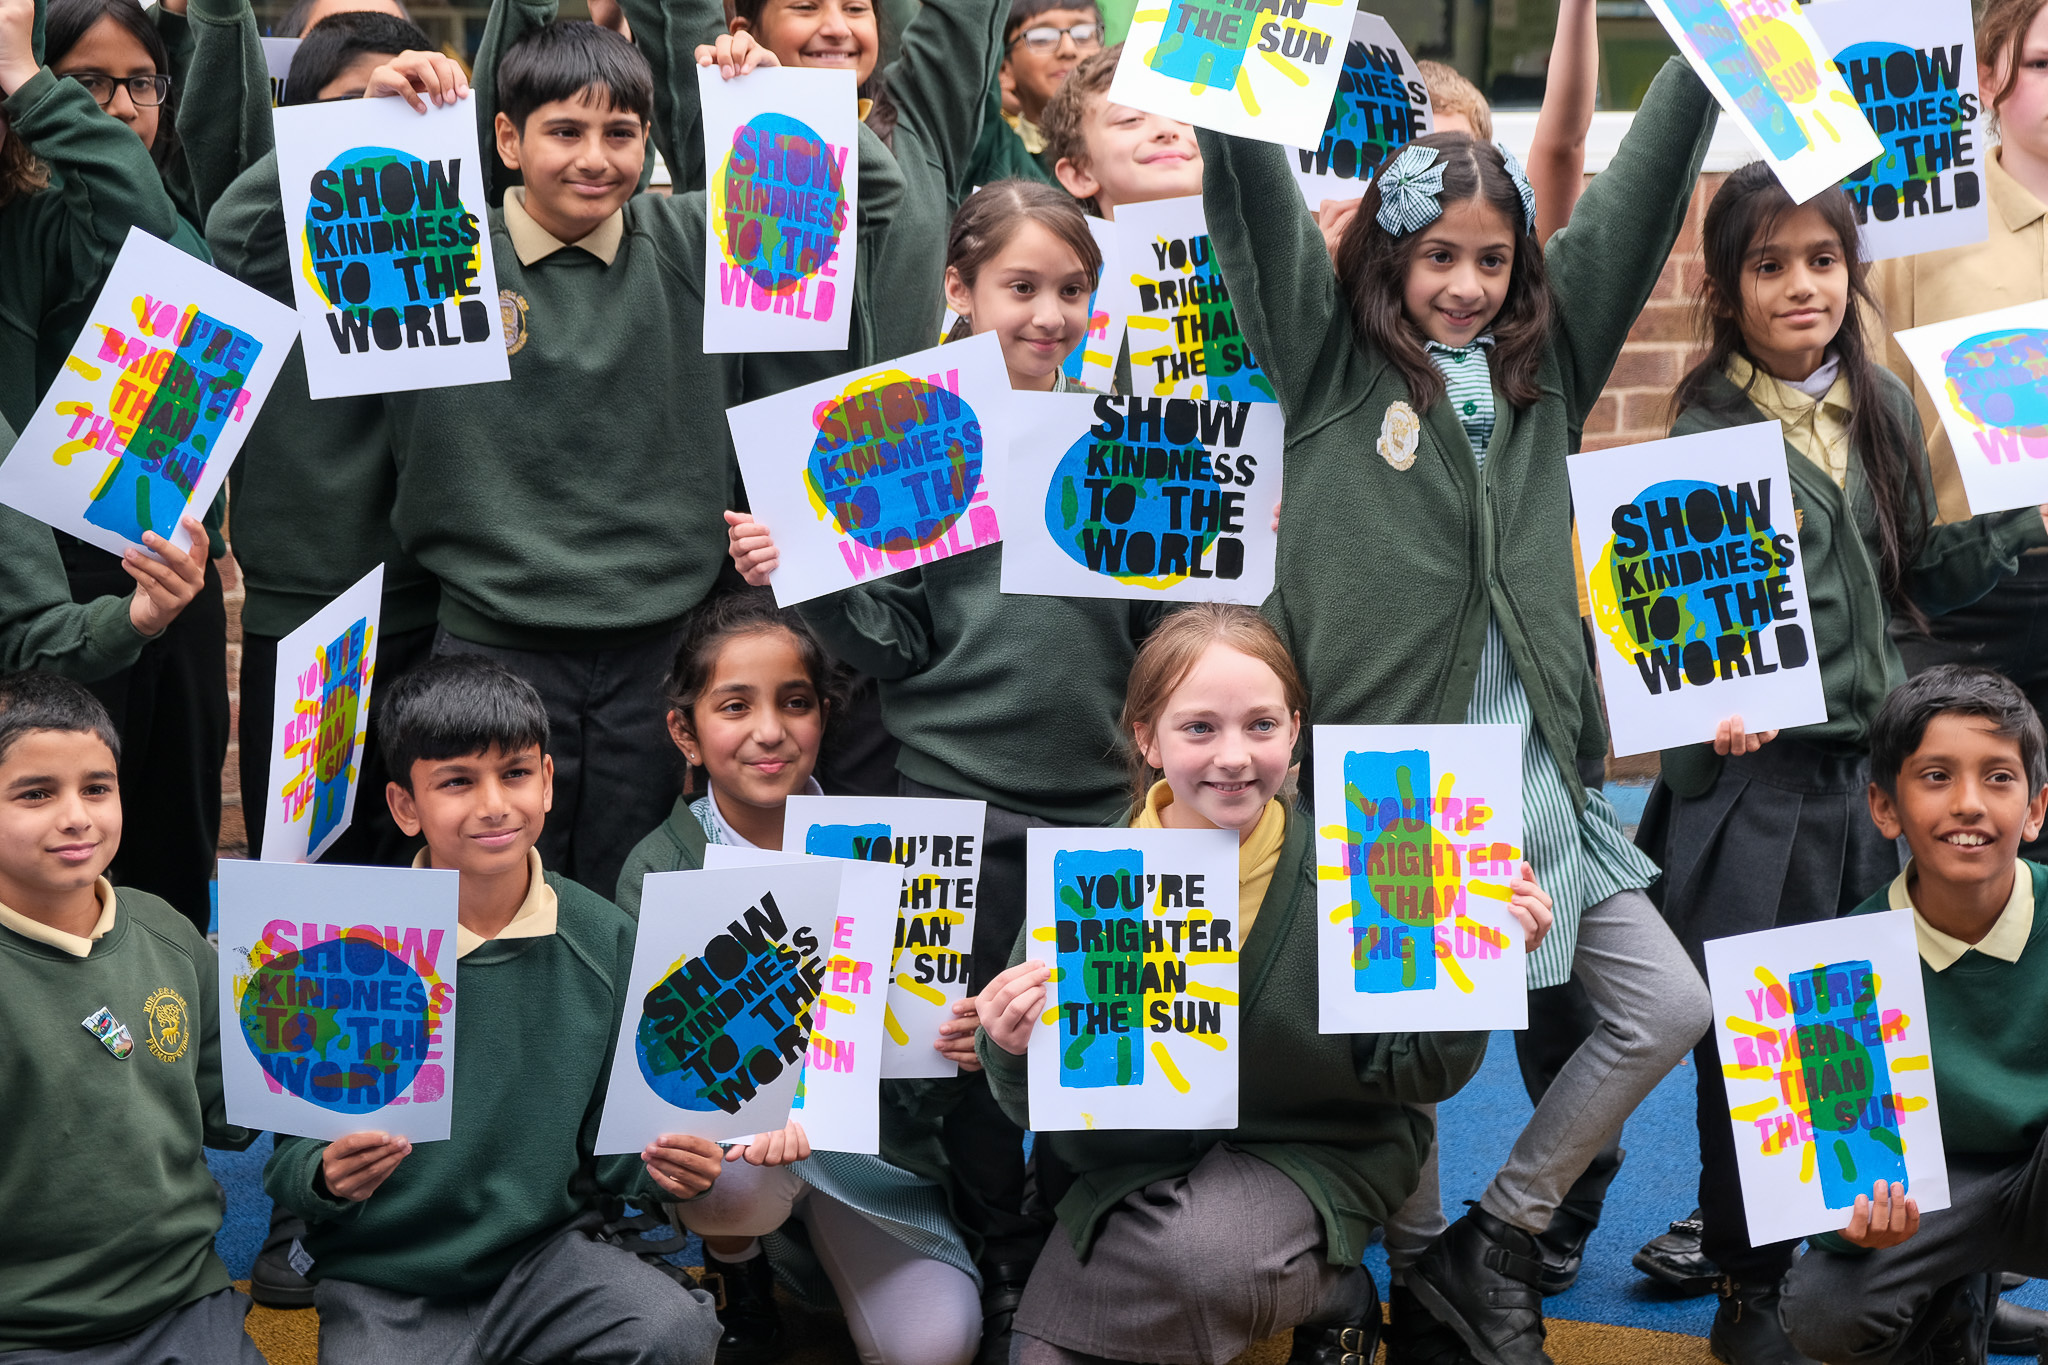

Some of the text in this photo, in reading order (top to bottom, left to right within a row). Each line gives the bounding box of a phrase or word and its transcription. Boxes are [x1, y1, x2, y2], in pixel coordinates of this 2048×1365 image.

[1177, 4, 1332, 64] THE SUN
[1344, 40, 1404, 75] OW
[1338, 71, 1427, 105] DNESS
[1771, 58, 1822, 103] SUN
[1835, 44, 1963, 103] HOW
[1356, 101, 1426, 144] THE
[1866, 93, 1978, 134] DNESS
[730, 125, 848, 192] SHOW
[1299, 136, 1394, 181] WOR
[1895, 129, 1975, 176] THE
[310, 158, 462, 222] SHOW
[726, 177, 849, 231] KINDNESS
[313, 213, 480, 260] KINDNESS
[725, 212, 840, 277] TO THE
[1151, 236, 1214, 271] YOU
[316, 260, 371, 306] TO
[394, 253, 481, 305] THE
[720, 262, 836, 322] WORLD
[1139, 273, 1229, 312] BRIGH
[326, 300, 489, 354] WORLD
[97, 327, 251, 422] BRIGHTER
[1152, 343, 1259, 383] THE SU
[112, 379, 199, 442] THAN
[813, 369, 961, 452] SHOW
[1090, 394, 1252, 448] SHOW
[1958, 393, 2015, 425] TO
[67, 405, 207, 491] THE SUN
[820, 421, 983, 489] KINDNESS
[1087, 444, 1257, 487] KINDNESS
[825, 460, 988, 533] TO THE
[1084, 478, 1245, 533] TO THE
[1611, 478, 1771, 558] SHOW
[838, 505, 1000, 581] WORLD
[1082, 528, 1244, 580] WORLD
[1618, 533, 1795, 598] KINDNESS
[1622, 575, 1798, 645] TO THE
[1634, 623, 1809, 695] WORLD
[284, 656, 369, 756] BRIGHTER
[300, 711, 347, 775] THAN
[282, 732, 356, 824] THE SUN
[1341, 841, 1512, 877] BRIGHTER
[1374, 885, 1467, 919] THAN
[260, 919, 445, 977] SHOW
[643, 891, 788, 1035] SHOW
[1057, 918, 1232, 953] BRIGHTER
[1348, 925, 1501, 961] THE SUN
[259, 973, 455, 1015] KINDNESS
[665, 926, 819, 1062] KINDNESS
[1092, 960, 1187, 995] THAN
[256, 1006, 443, 1061] TO THE
[680, 1034, 740, 1086] TO
[749, 956, 827, 1031] THE
[1064, 1000, 1221, 1035] THE SUN
[1733, 1009, 1906, 1071] BRIGHTER
[259, 1054, 445, 1106] WORLD
[707, 1011, 813, 1115] WOR
[1773, 1056, 1866, 1105] THAN
[1754, 1092, 1906, 1153] THE SUN
